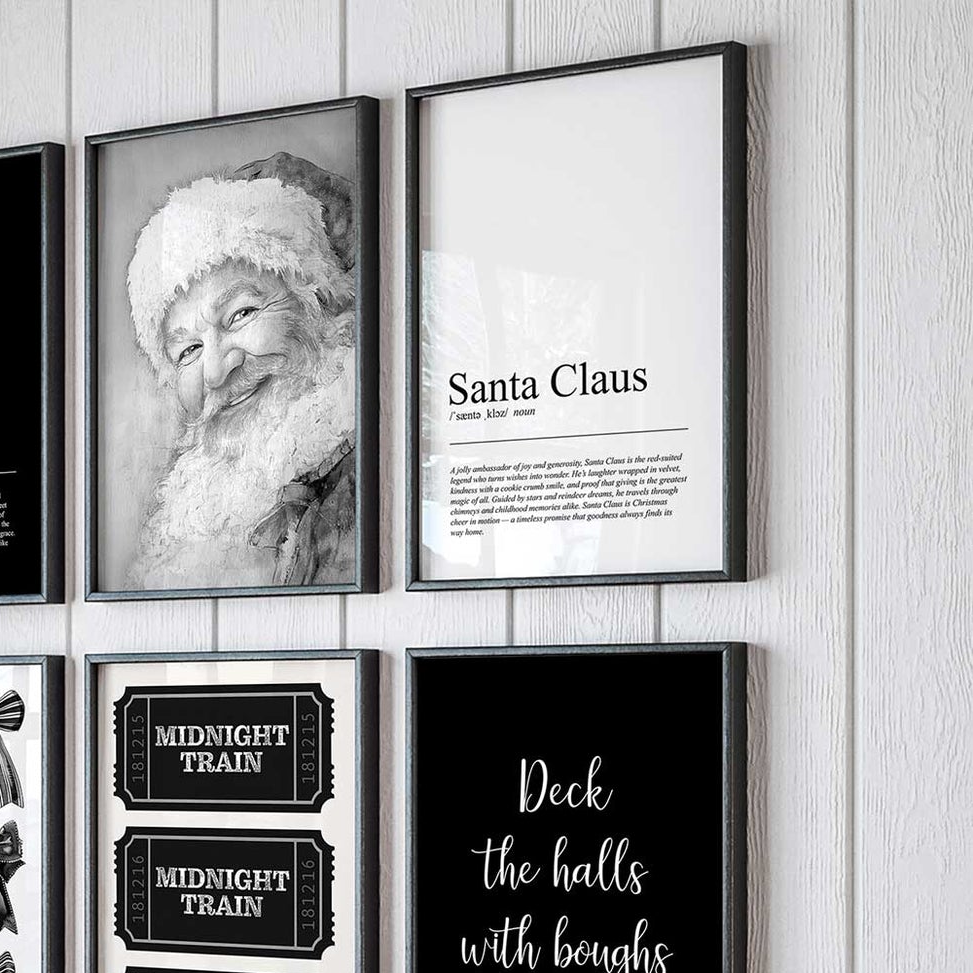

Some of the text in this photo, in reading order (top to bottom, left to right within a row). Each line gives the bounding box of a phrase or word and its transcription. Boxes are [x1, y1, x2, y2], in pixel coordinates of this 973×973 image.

[449, 362, 647, 406] Santa Claus
[513, 408, 536, 417] noun
[450, 453, 683, 476] A jolly ambassador of joy and generosity, Santa Claus is the red-suited
[450, 476, 472, 486] legend
[471, 475, 487, 483] who
[505, 473, 528, 482] wishes
[528, 472, 543, 480] into
[542, 471, 570, 480] wonder.
[570, 470, 587, 478] He's
[586, 468, 617, 479] laughter
[616, 466, 649, 477] wrapped
[648, 466, 657, 474] in
[657, 465, 681, 473] velvet,
[450, 486, 478, 495] kindness
[478, 484, 494, 493] with
[499, 483, 522, 492] cookie
[522, 482, 545, 491] crumb
[544, 481, 566, 490] smile,
[565, 480, 581, 489] and
[580, 479, 600, 490] proof
[600, 478, 615, 487] that
[614, 477, 638, 488] giving
[638, 477, 645, 485] is
[645, 476, 658, 484] the
[658, 476, 687, 486] greatest
[450, 496, 470, 506] magic
[470, 495, 479, 505] of
[478, 495, 491, 503] all.
[490, 494, 516, 503] Guided
[516, 493, 525, 503] by
[543, 491, 558, 500] and
[557, 491, 586, 499] reindeer
[586, 490, 615, 498] dreams,
[614, 488, 625, 497] he
[624, 487, 650, 496] travels
[649, 485, 679, 496] through
[450, 498, 668, 516] chimneys and childhood memories alike. Santa Claus is Christmas
[450, 518, 468, 526] cheer
[468, 517, 477, 525] in
[476, 516, 500, 525] motion
[515, 514, 543, 523] timeless
[543, 513, 571, 524] promise
[571, 512, 586, 521] that
[585, 511, 619, 522] goodness
[618, 510, 644, 520] always
[643, 509, 663, 519] finds
[662, 508, 673, 516] its
[450, 528, 485, 538] way home.
[155, 725, 289, 746] MIDNIGHT
[132, 715, 145, 782] 181215
[301, 713, 315, 783] 181215
[180, 751, 263, 773] TRAIN
[520, 755, 613, 813] Deck
[471, 834, 649, 895] the halls
[132, 855, 145, 922] 181216
[155, 866, 289, 892] MIDNIGHT
[181, 894, 263, 917] TRAIN
[301, 860, 315, 929] 181216
[461, 914, 541, 970] with
